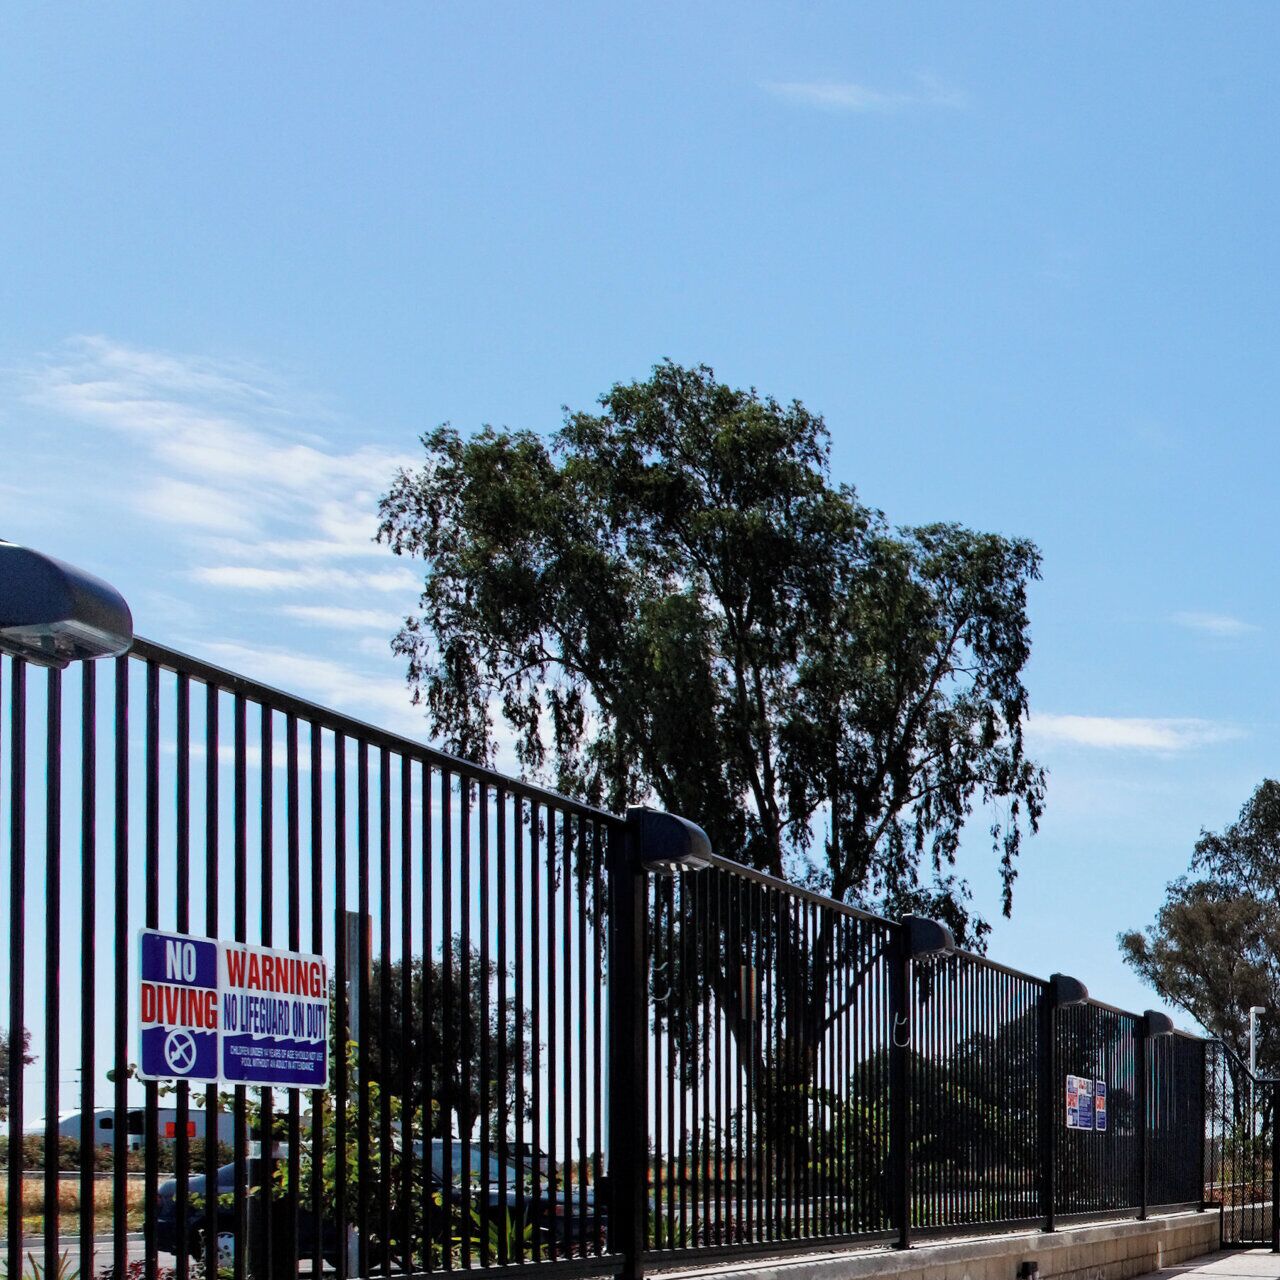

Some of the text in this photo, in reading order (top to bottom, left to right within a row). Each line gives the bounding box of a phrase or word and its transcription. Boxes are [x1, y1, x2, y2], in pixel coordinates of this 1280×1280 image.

[166, 940, 197, 982] NO
[226, 949, 327, 998] WARNING!
[141, 984, 218, 1029] DIVING
[224, 993, 327, 1040] NO LIFEGUARD ON DUTY
